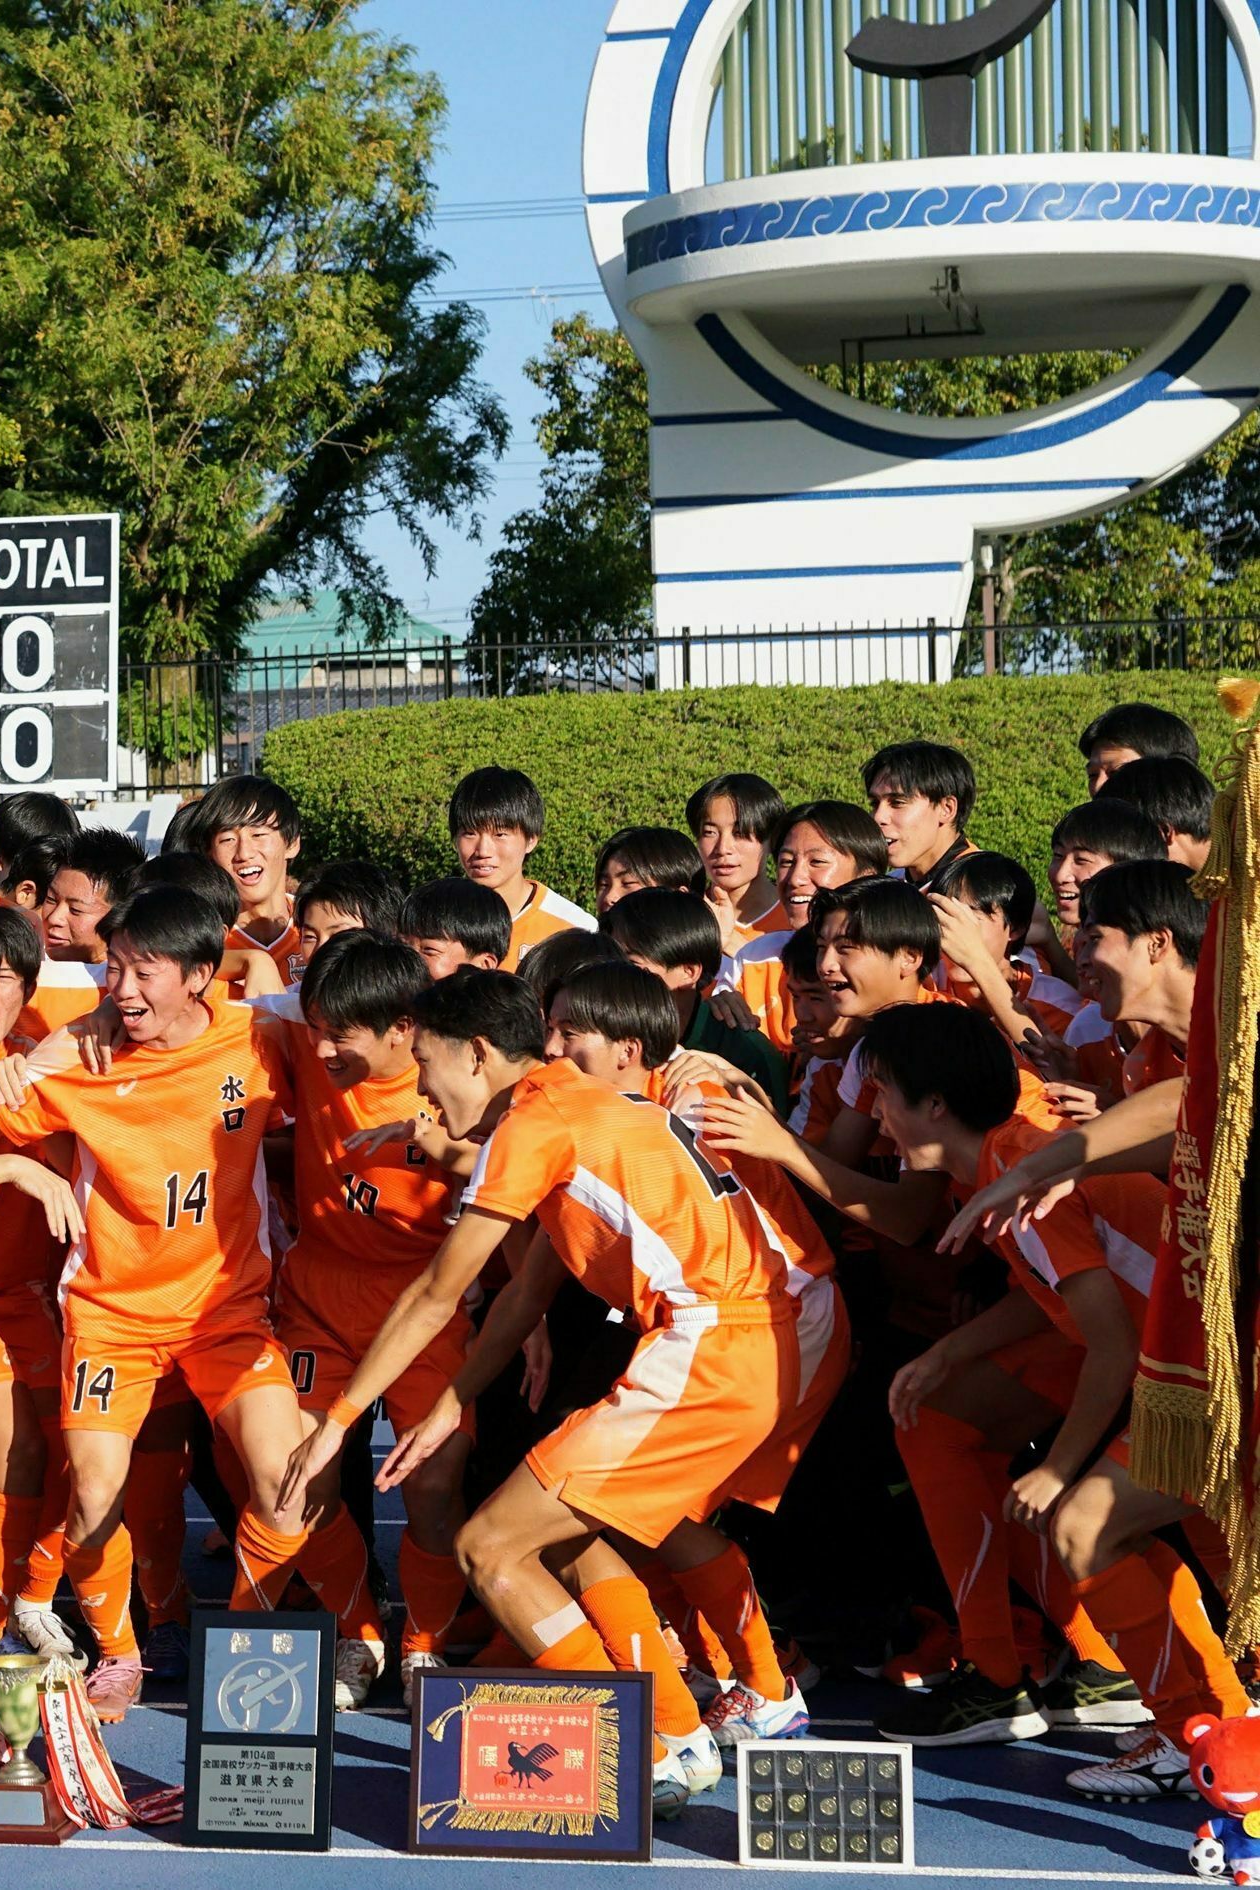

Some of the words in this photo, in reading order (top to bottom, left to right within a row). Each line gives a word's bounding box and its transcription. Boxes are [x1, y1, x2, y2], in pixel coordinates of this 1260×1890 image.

[1, 615, 54, 691] 0
[1, 706, 54, 782] 0
[221, 1074, 246, 1133] 水口
[164, 1169, 210, 1231] 14
[71, 1359, 115, 1414] 14
[202, 1759, 312, 1772] 全国高校サッカー選手権大会
[220, 1773, 294, 1788] 滋賀県大会
[241, 1750, 276, 1760] 第104回
[244, 1796, 265, 1805] meiji
[271, 1798, 304, 1806] FUJIFILM
